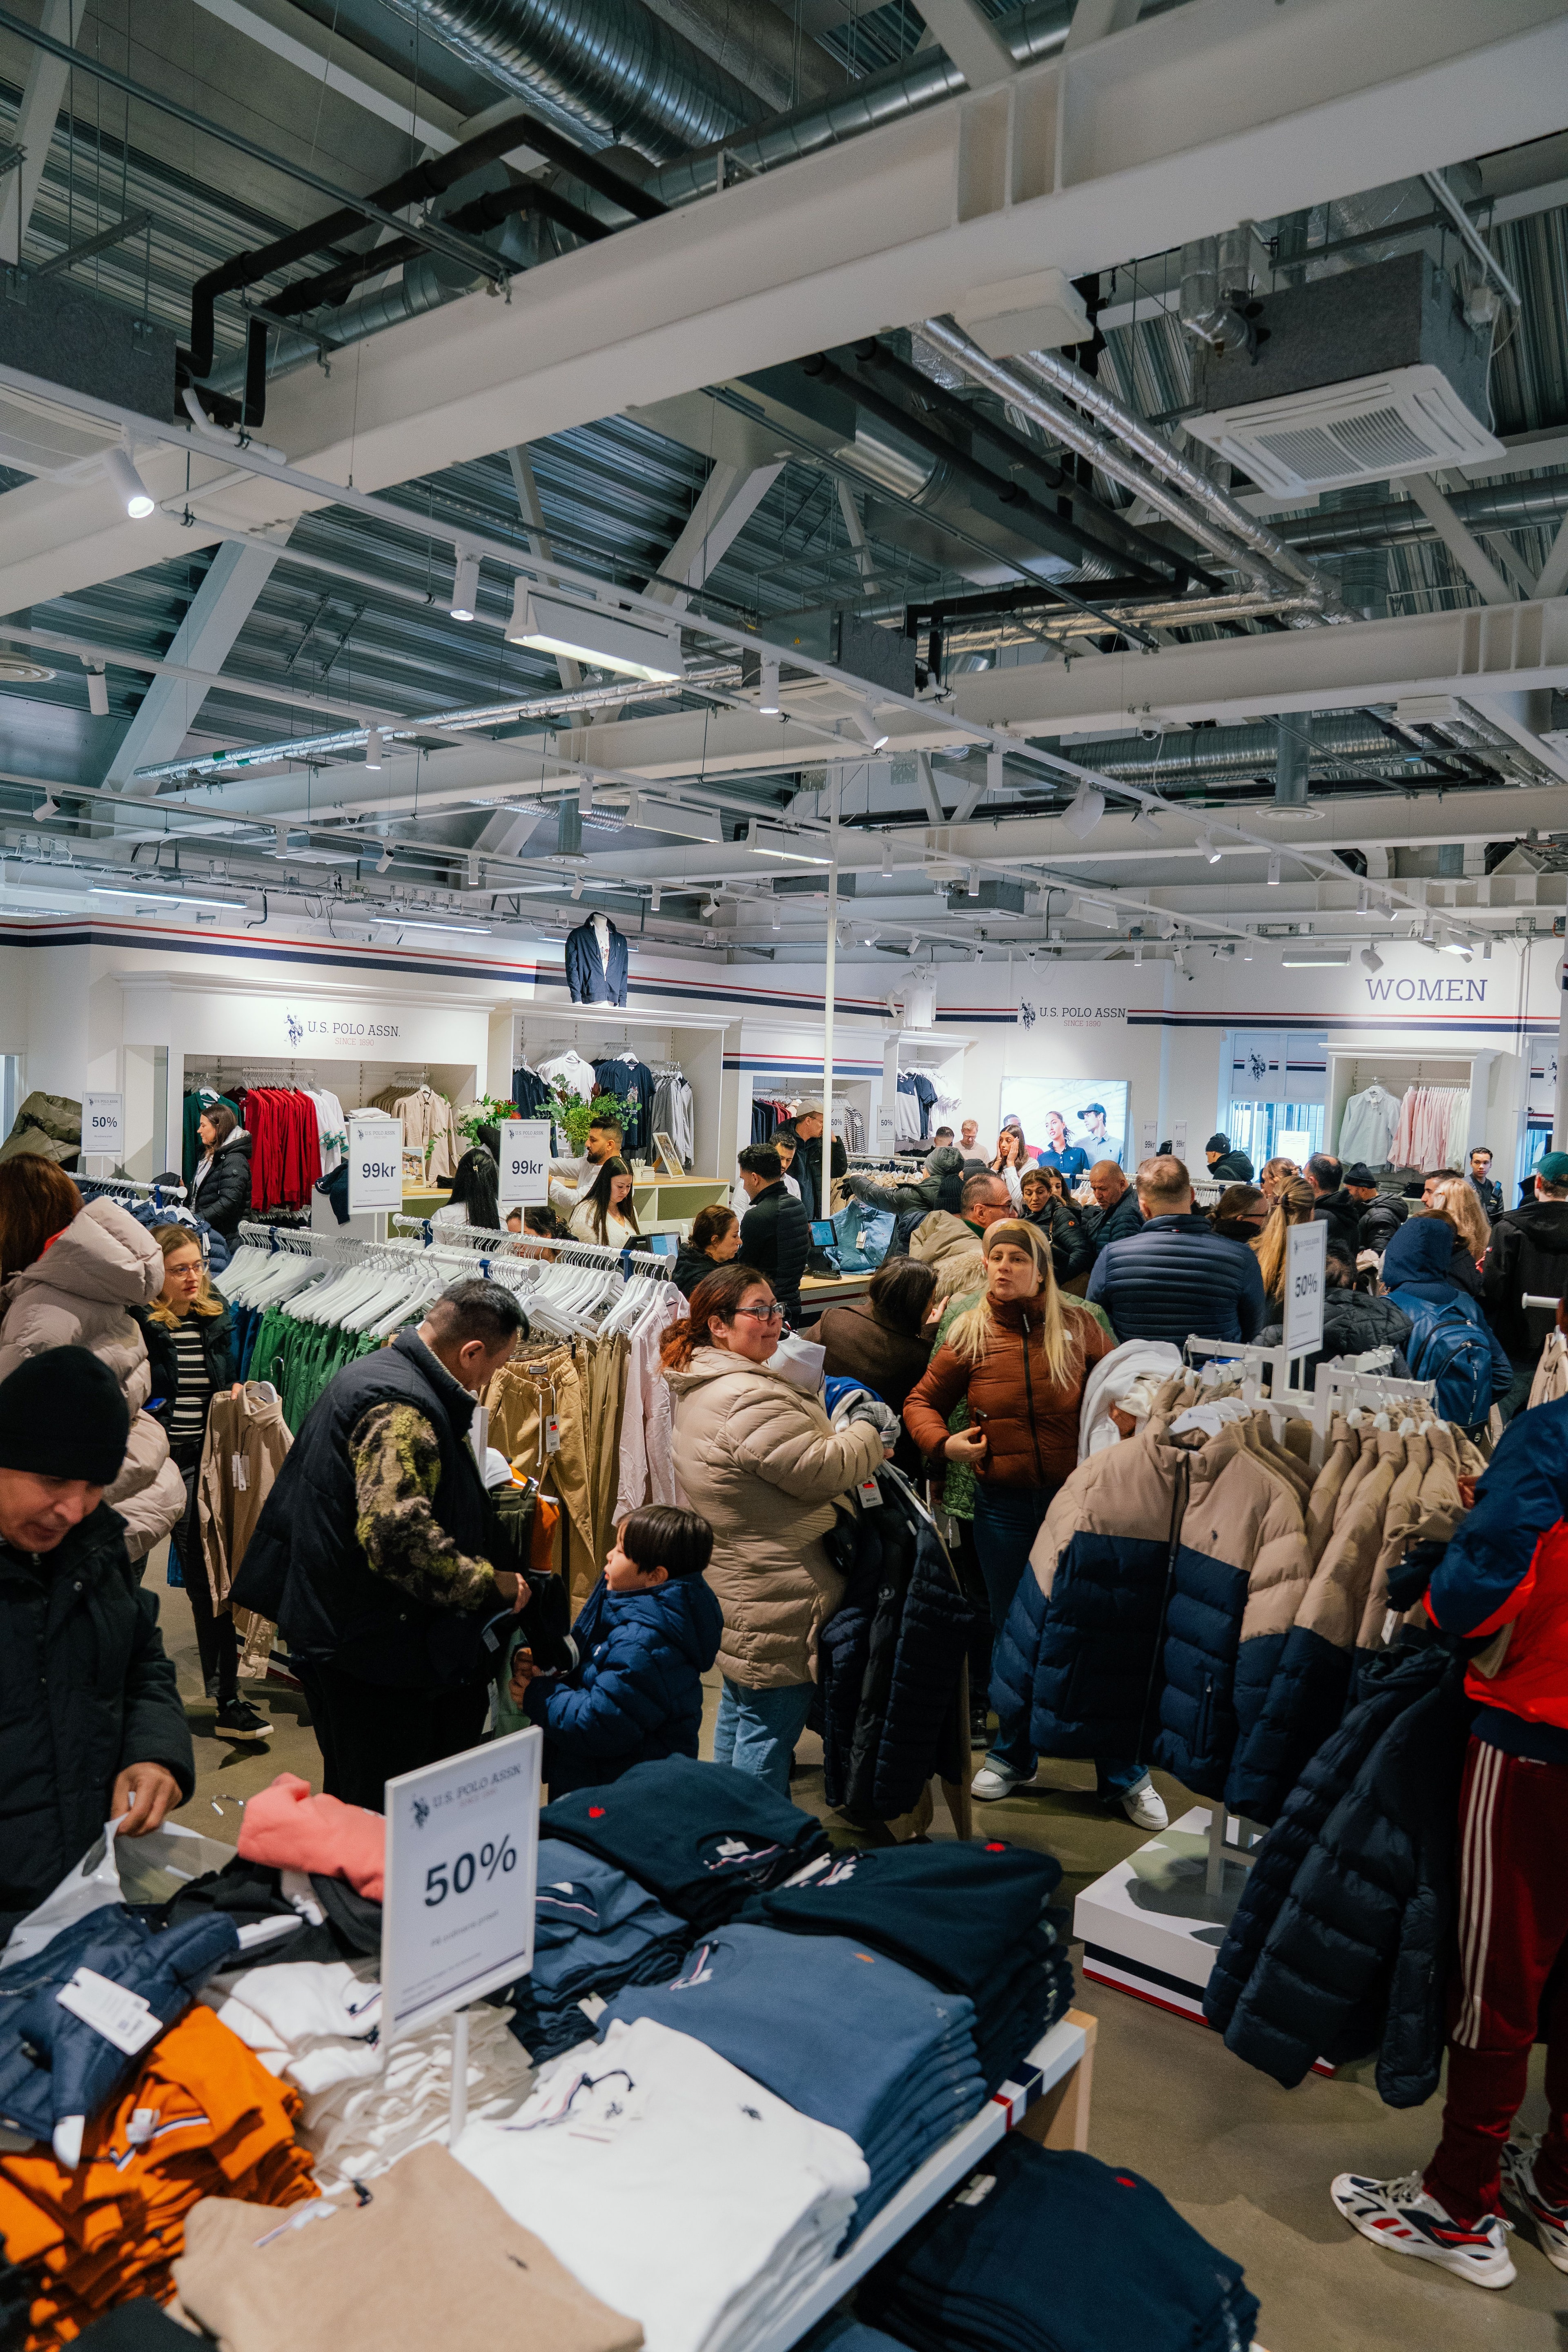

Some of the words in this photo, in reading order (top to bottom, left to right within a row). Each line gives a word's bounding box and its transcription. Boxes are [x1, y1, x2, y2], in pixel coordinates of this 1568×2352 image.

[1365, 978, 1488, 1001] WOMEN
[1039, 1007, 1059, 1017] U.S.
[1061, 1007, 1092, 1018] POLO
[1094, 1008, 1128, 1018] ASSN.
[307, 1021, 329, 1033] U.S.
[333, 1022, 365, 1035] POLO
[368, 1025, 401, 1037] ASSN.
[335, 1037, 356, 1046] SINCE
[92, 1116, 117, 1127] 50%
[362, 1162, 396, 1178] 99kr
[512, 1160, 543, 1174] 99kr
[1295, 1272, 1317, 1298] 50%
[457, 1776, 489, 1798] POLO
[425, 1834, 517, 1907] 50%
